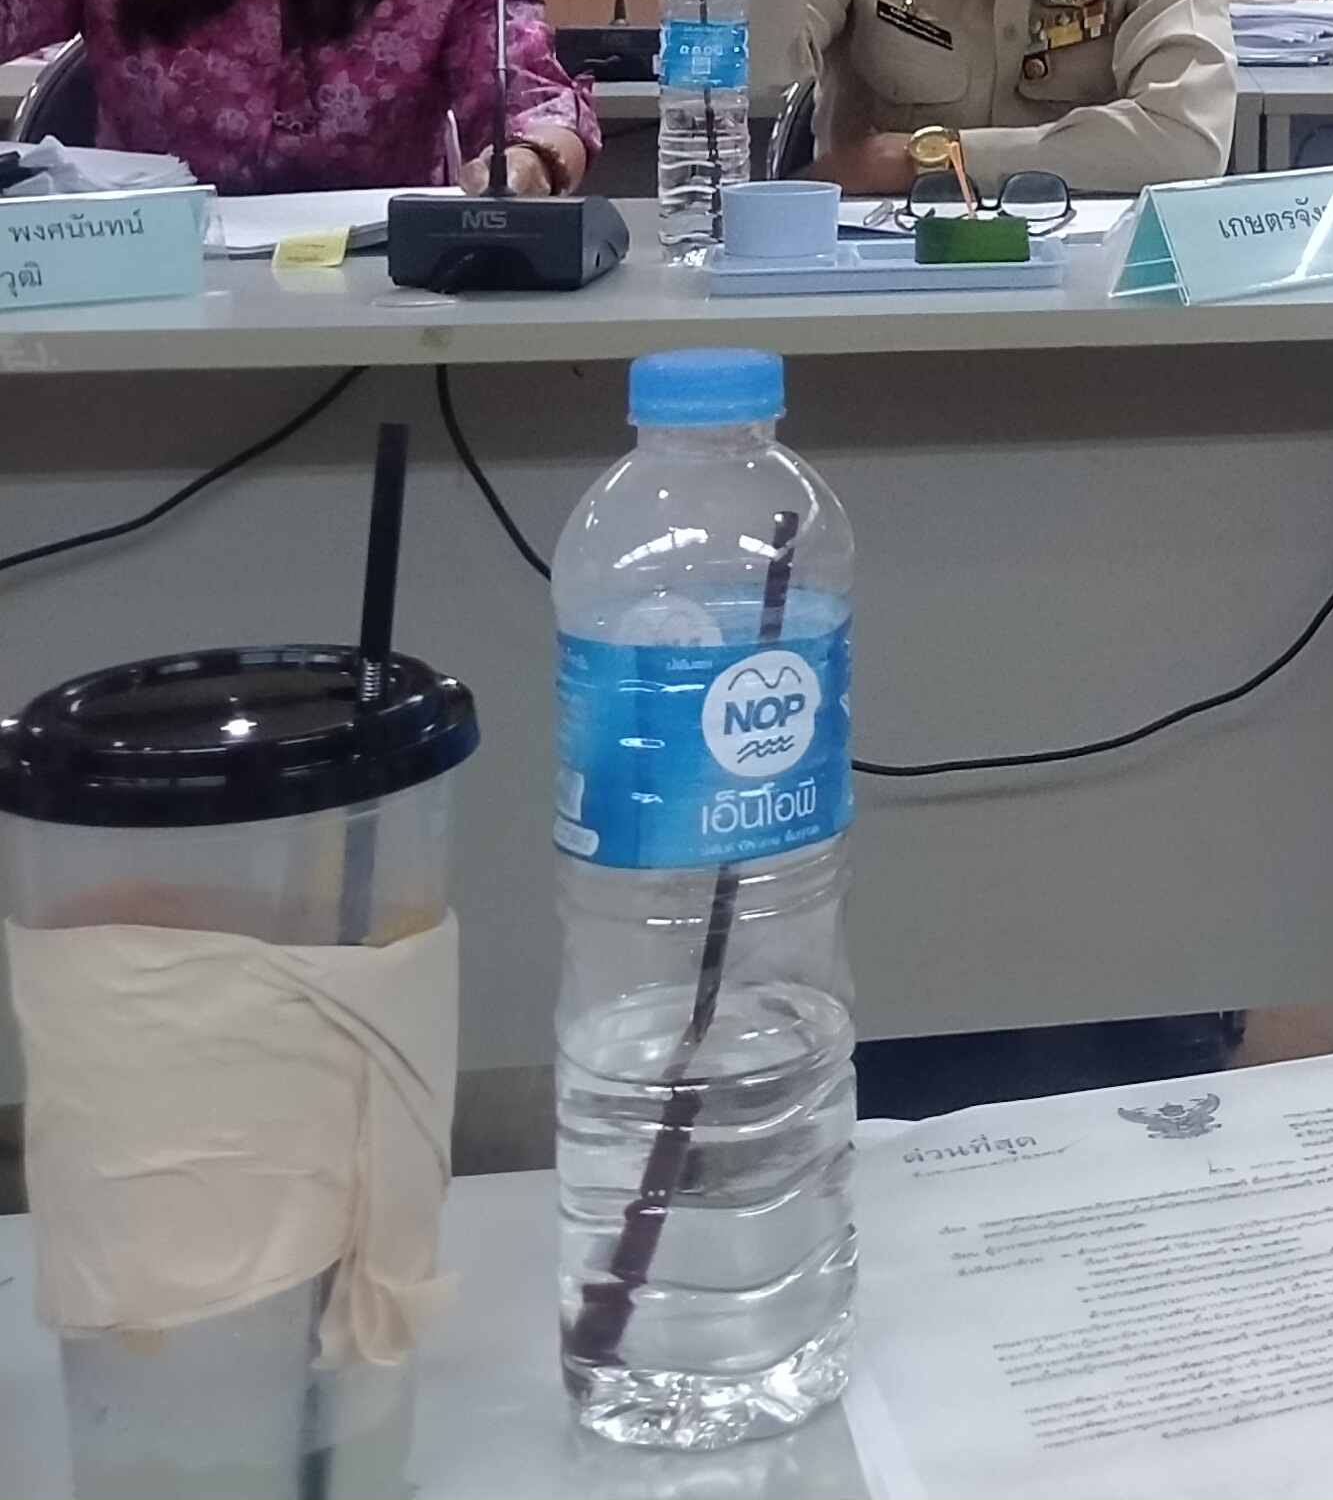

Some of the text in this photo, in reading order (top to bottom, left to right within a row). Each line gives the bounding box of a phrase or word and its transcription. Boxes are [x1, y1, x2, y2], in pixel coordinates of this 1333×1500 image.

[8, 209, 145, 242] พงศนันทน์
[724, 693, 805, 735] NOP
[903, 1134, 1037, 1163] ด่วนที่สุด
